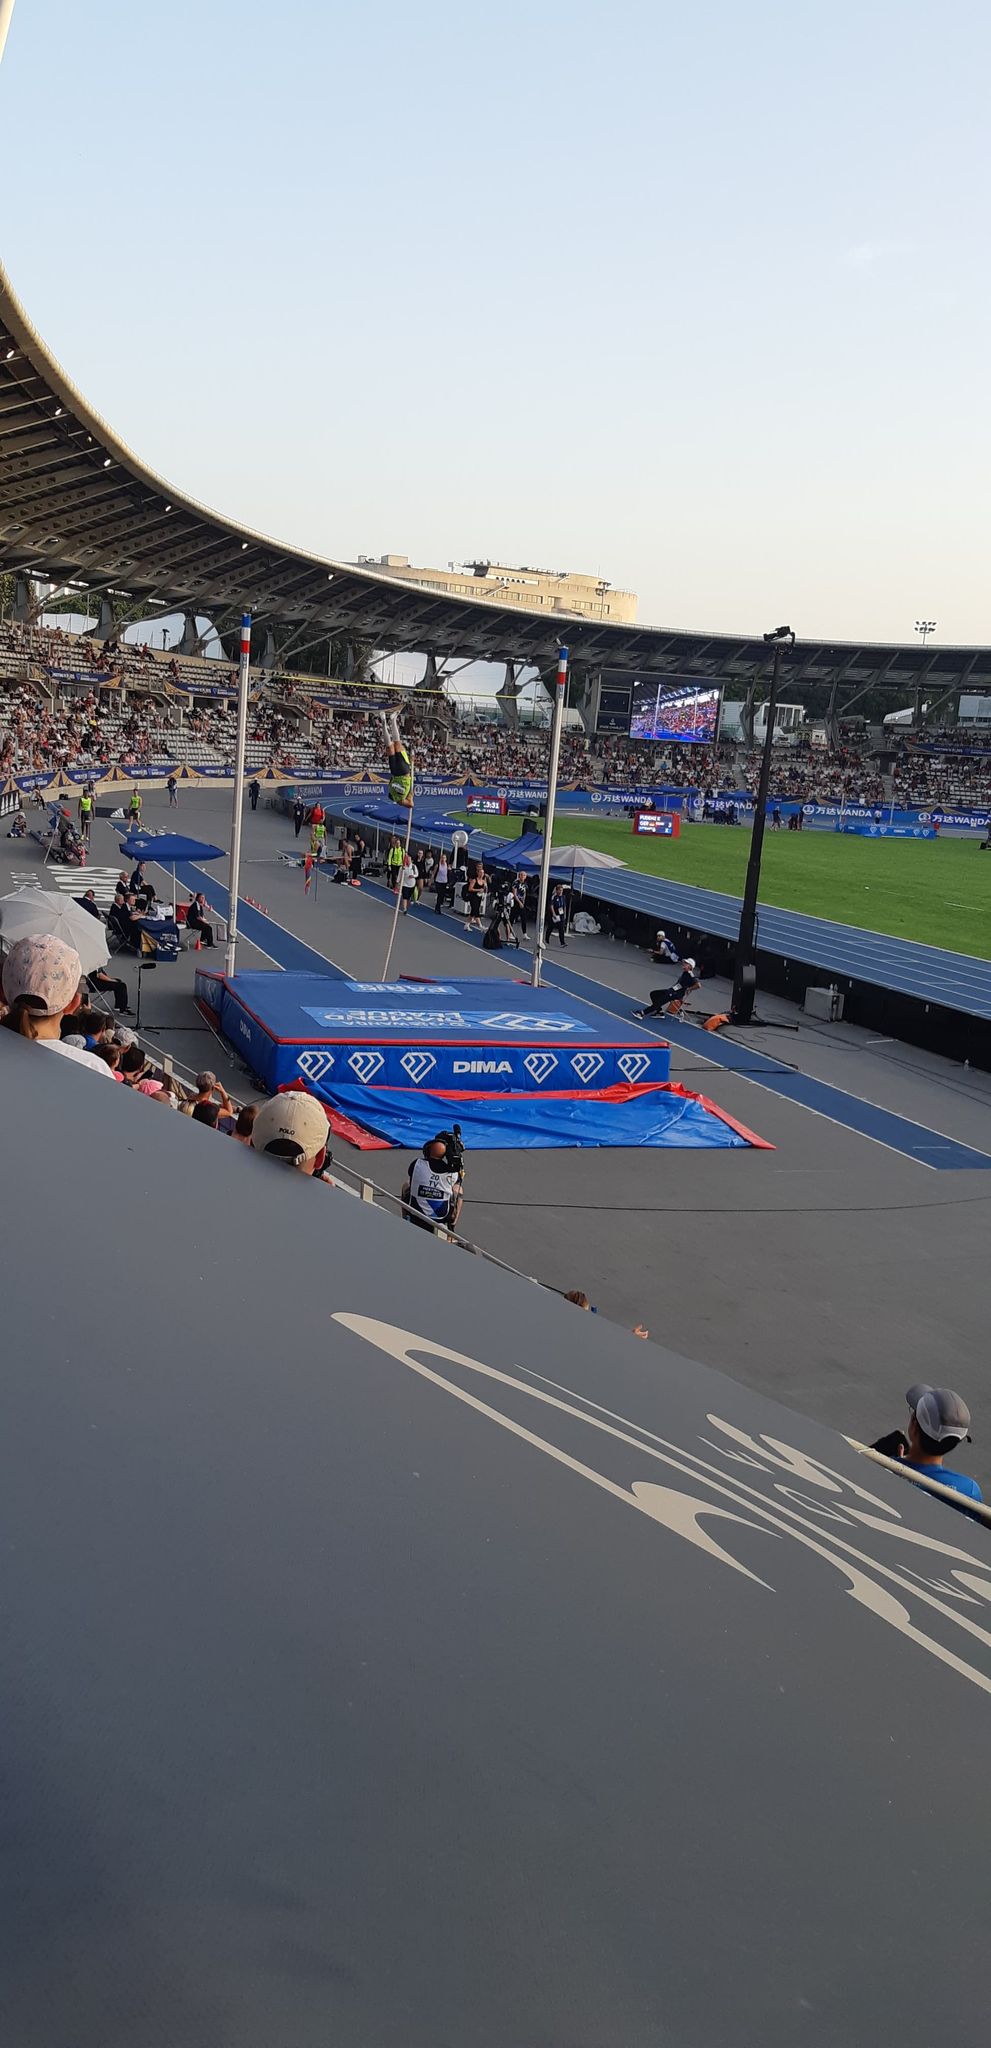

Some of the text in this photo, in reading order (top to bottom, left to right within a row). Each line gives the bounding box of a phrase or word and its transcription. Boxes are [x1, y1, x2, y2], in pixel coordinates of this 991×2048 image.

[507, 788, 548, 799] 万达WAND
[453, 1060, 513, 1074] DIMA
[279, 1127, 295, 1136] POLO
[429, 1180, 439, 1188] TV
